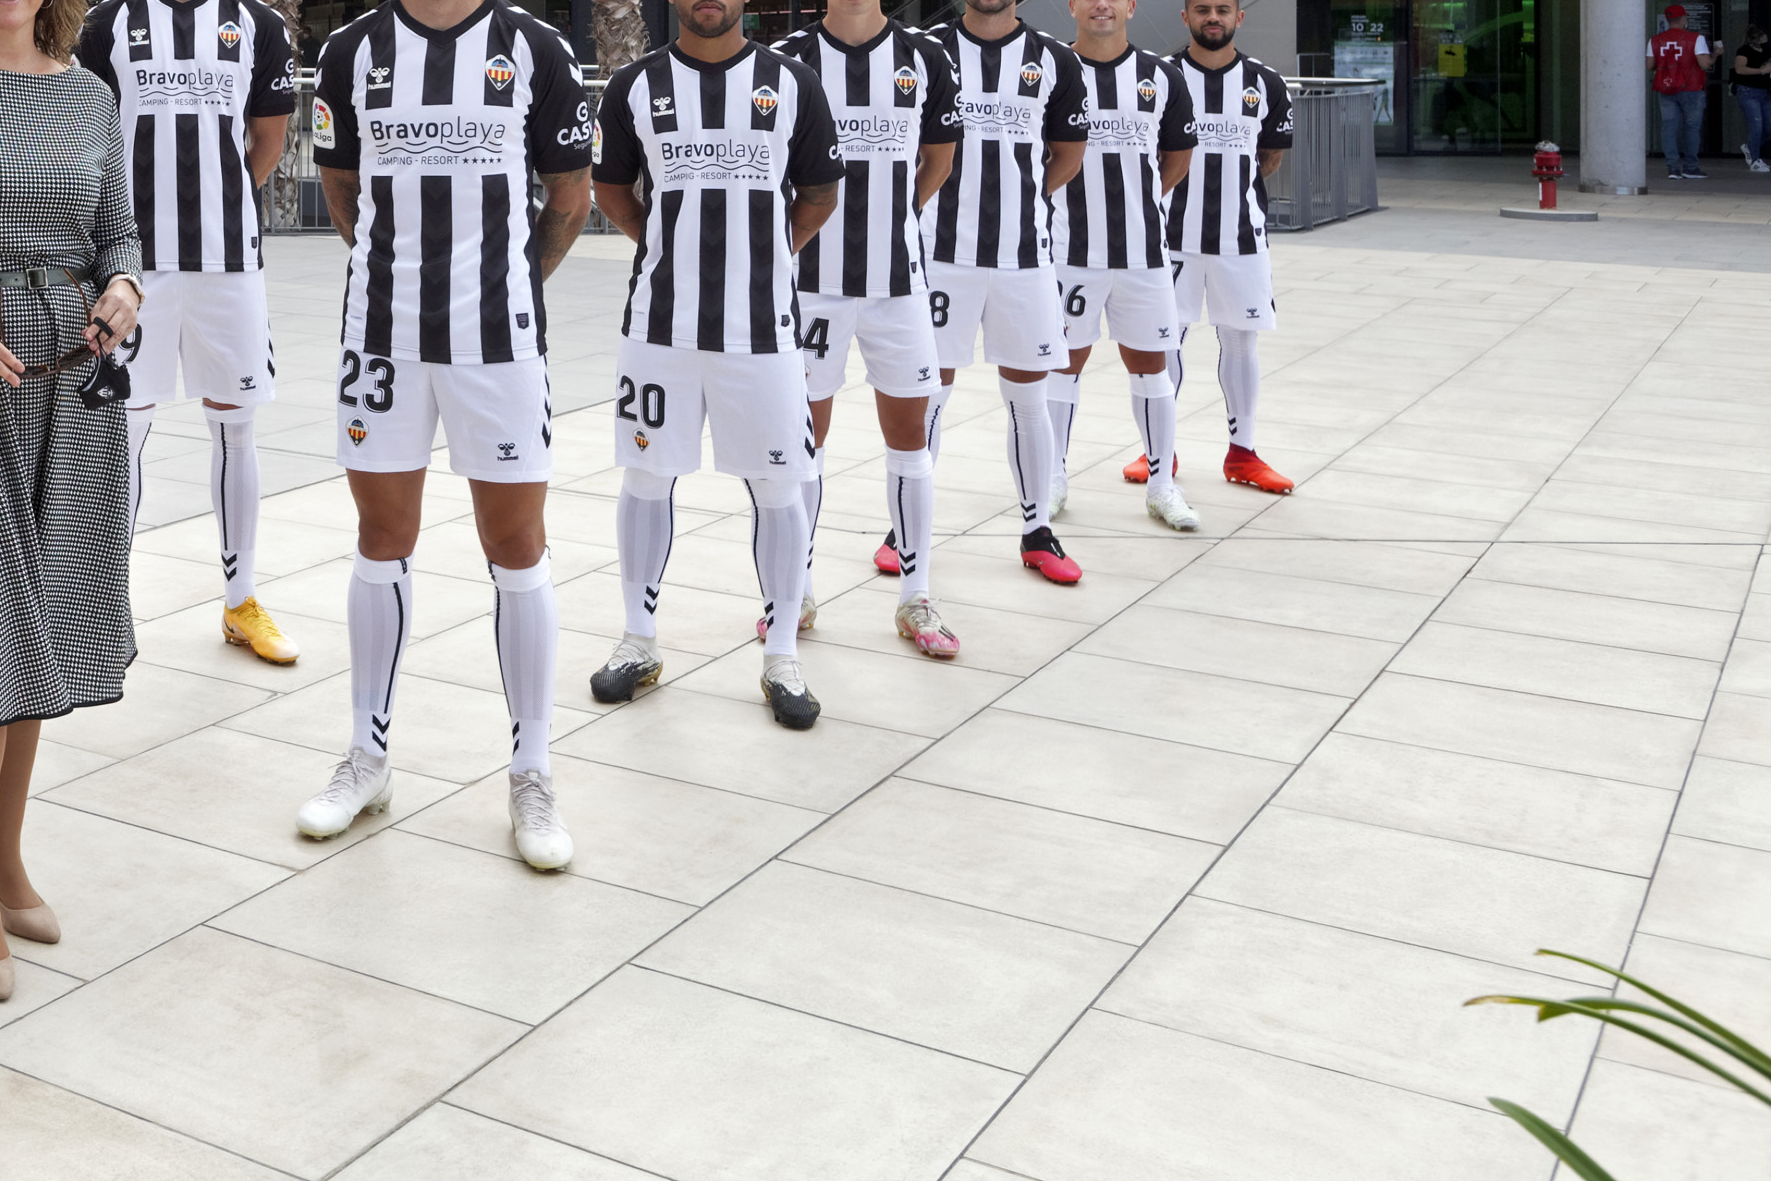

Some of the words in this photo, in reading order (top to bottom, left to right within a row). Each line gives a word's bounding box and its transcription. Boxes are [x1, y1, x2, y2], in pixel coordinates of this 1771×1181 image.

[1351, 22, 1364, 32] 10
[1370, 22, 1384, 32] 22
[136, 68, 234, 91] Bravoplaya
[367, 80, 391, 91] hummel
[174, 97, 203, 106] RESORT
[652, 108, 675, 118] hummel
[370, 115, 506, 145] Bravoplaya
[661, 139, 770, 164] Bravoplaya
[845, 144, 876, 153] RESORT
[377, 155, 413, 166] CAMPING
[420, 155, 460, 166] RESORT
[700, 171, 732, 180] RESORT
[338, 349, 397, 413] 23
[616, 375, 666, 429] 20
[496, 454, 519, 463] hummel
